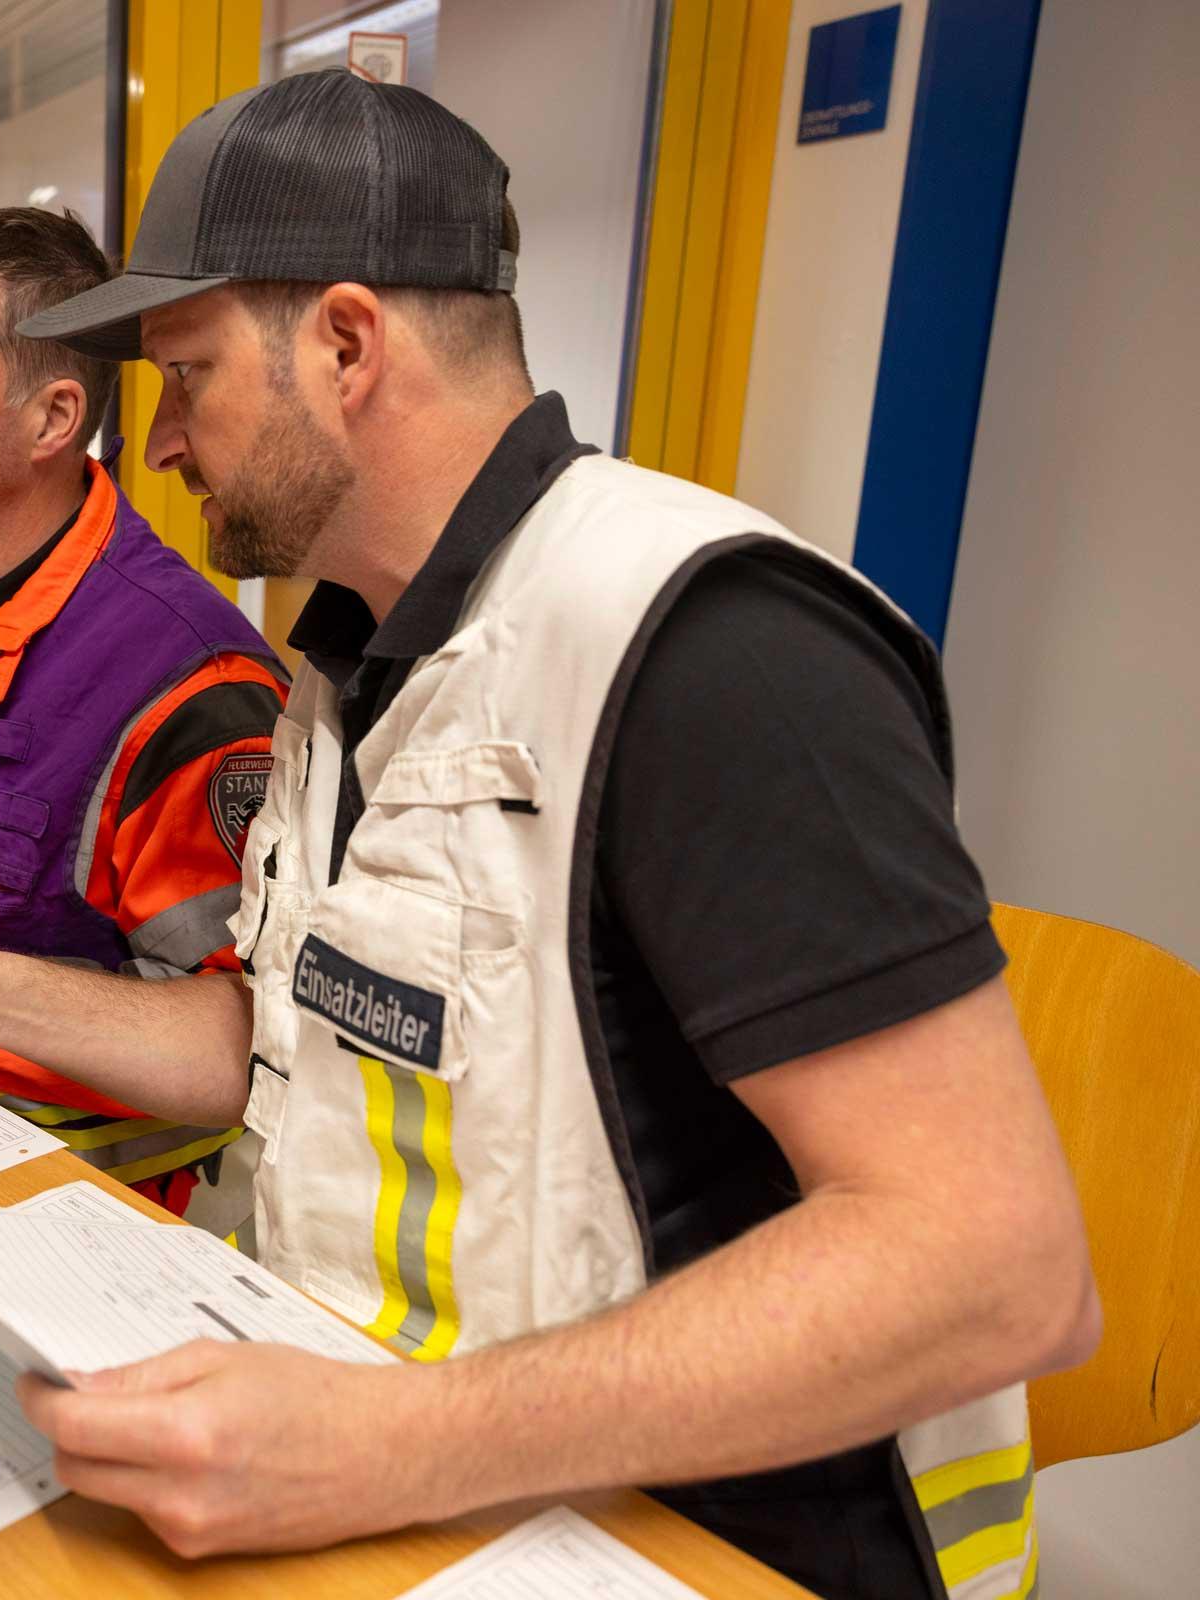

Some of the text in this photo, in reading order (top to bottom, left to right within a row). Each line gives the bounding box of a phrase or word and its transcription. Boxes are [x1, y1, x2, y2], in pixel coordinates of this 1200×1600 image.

[228, 759, 273, 770] FEUERWEHR
[226, 776, 271, 794] STAN
[295, 953, 430, 1056] Einsatzleiter
